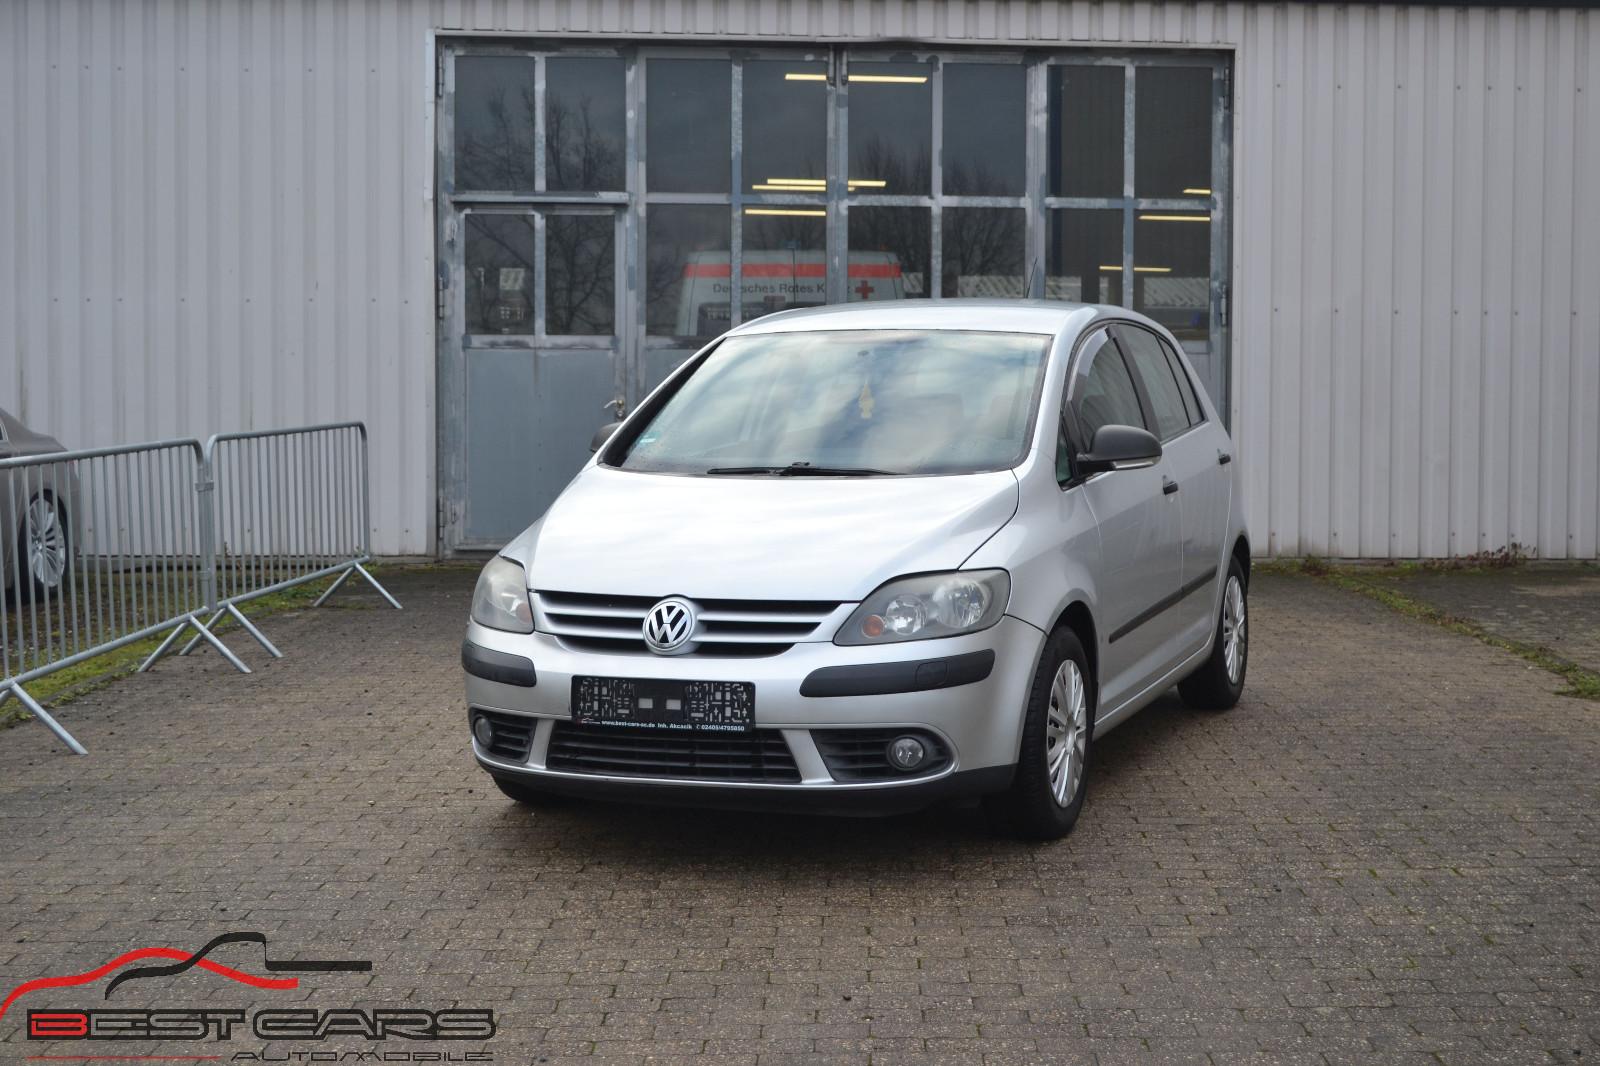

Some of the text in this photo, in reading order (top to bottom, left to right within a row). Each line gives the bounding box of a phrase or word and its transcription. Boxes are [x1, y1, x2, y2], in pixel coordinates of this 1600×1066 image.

[713, 283, 776, 293] Desches
[779, 283, 813, 293] Rotes
[645, 600, 693, 650] VW
